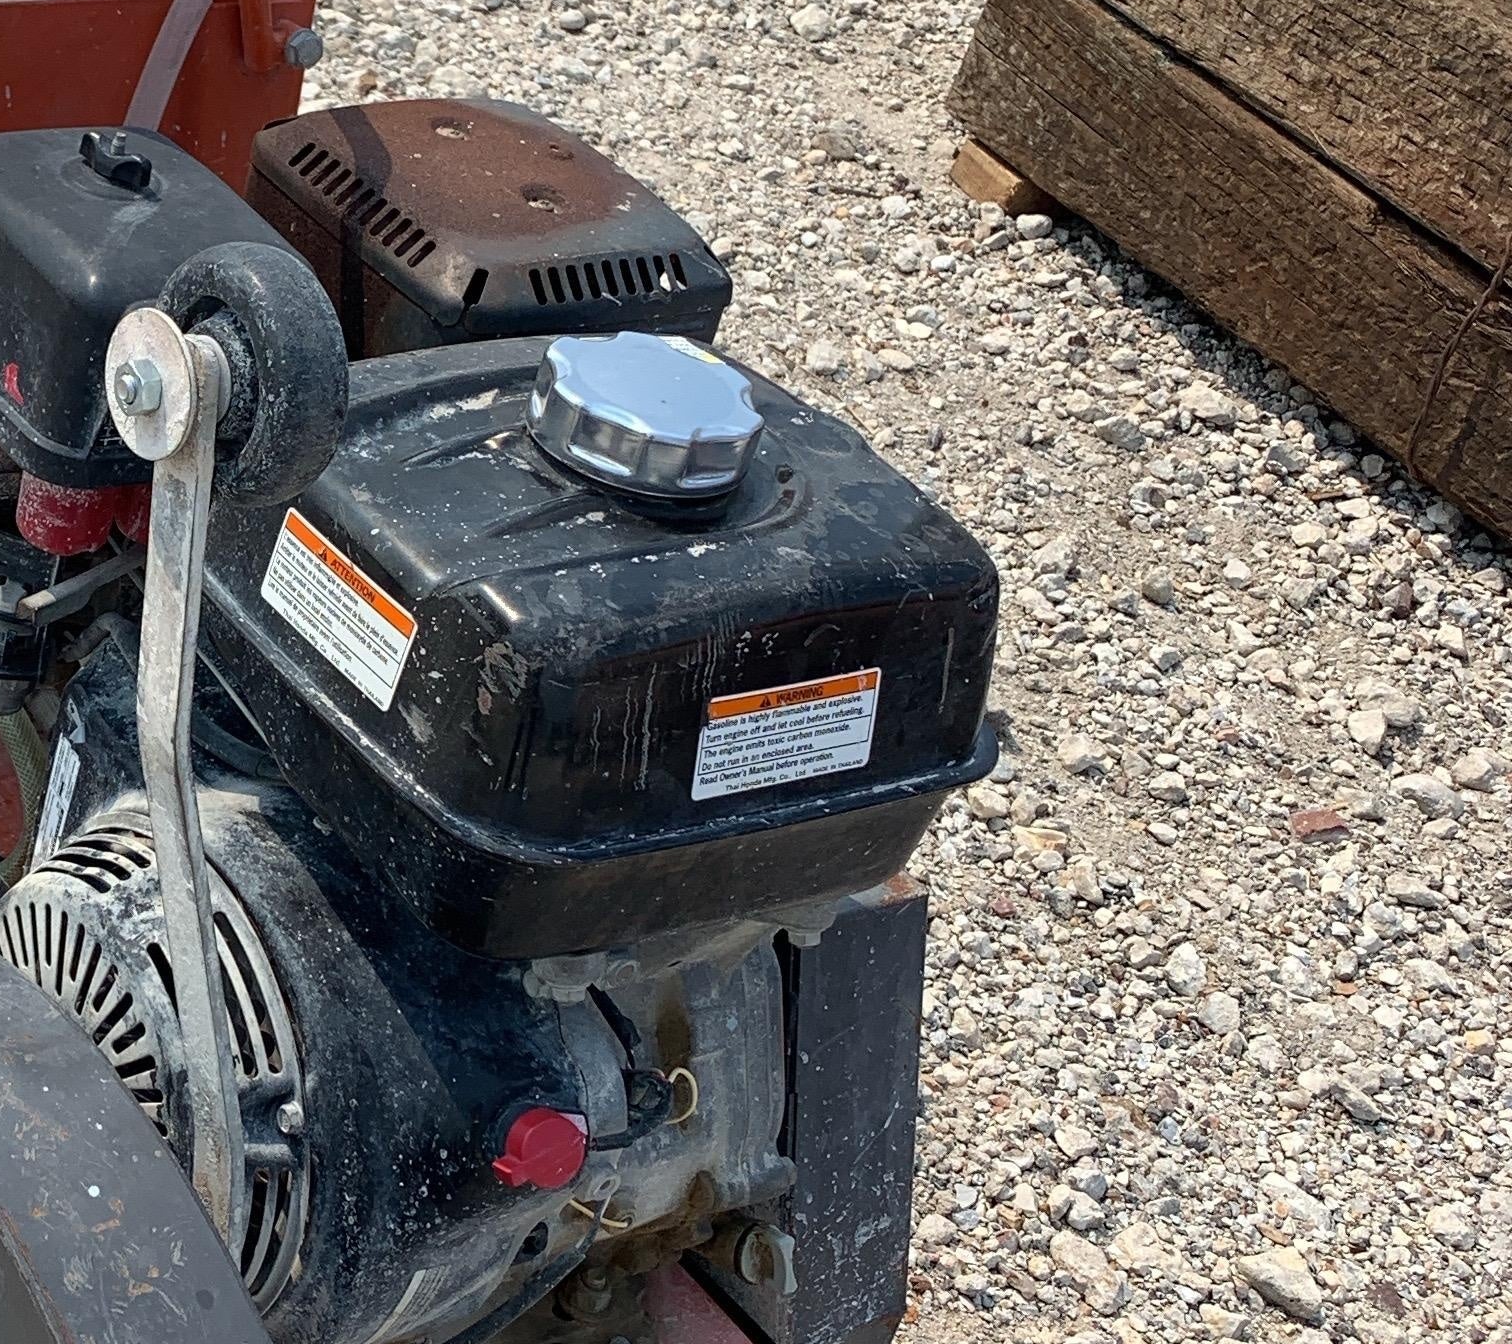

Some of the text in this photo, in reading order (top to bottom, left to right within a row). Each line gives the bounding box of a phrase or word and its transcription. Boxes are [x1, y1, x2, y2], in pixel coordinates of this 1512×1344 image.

[331, 560, 375, 602] ATTENTION
[776, 686, 824, 705] WARNING
[707, 719, 738, 730] Gasoline
[748, 713, 770, 723] highly
[772, 705, 810, 718] flammable
[813, 701, 826, 710] and
[829, 696, 862, 707] explosive.
[706, 735, 722, 743] Turn
[724, 730, 748, 740] engine
[750, 726, 760, 734] off
[762, 723, 776, 732] and
[778, 721, 787, 729] let
[789, 717, 804, 727] cool
[806, 714, 830, 723] before
[702, 763, 712, 771] Do
[714, 760, 726, 768] not
[727, 758, 740, 766] run
[742, 755, 748, 763] in
[762, 746, 794, 758] enclosed
[704, 750, 717, 758] The
[719, 745, 743, 755] engine
[746, 740, 765, 750] emits
[768, 737, 785, 745] toxic
[787, 732, 812, 741] carbon
[700, 775, 718, 785] Read
[720, 769, 746, 781] Owner's
[749, 763, 774, 775] Manual
[776, 760, 798, 770] before
[726, 783, 739, 791] Thai
[741, 780, 761, 788] Honda
[838, 759, 863, 768] THAILAND
